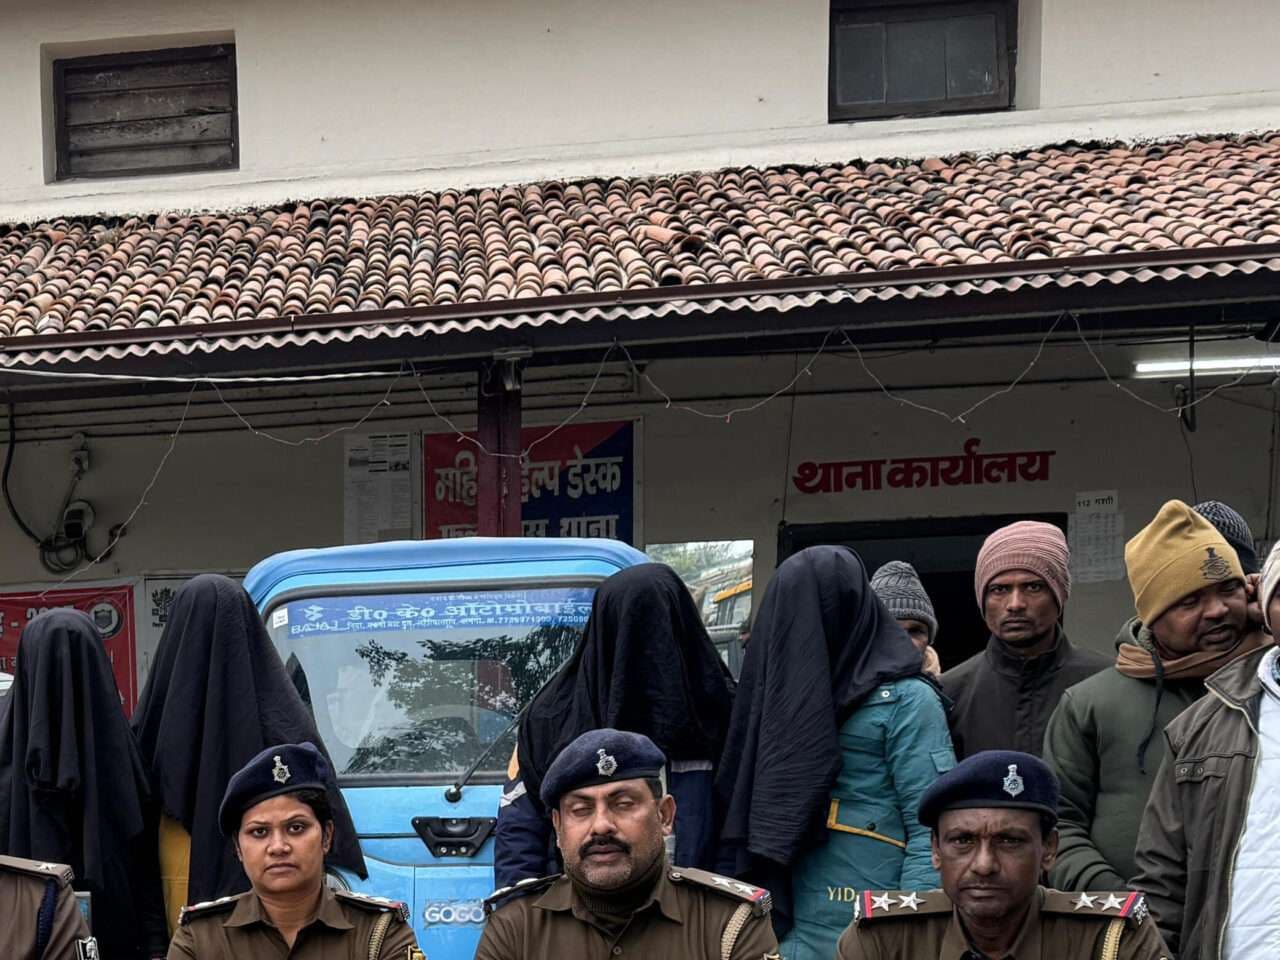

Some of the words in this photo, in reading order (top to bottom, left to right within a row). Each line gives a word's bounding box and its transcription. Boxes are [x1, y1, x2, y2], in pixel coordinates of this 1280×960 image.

[434, 450, 478, 507] महि
[567, 445, 624, 499] डेस्क
[792, 459, 887, 494] थाना
[887, 437, 1057, 488] कार्यालय
[425, 905, 487, 923] GOGO
